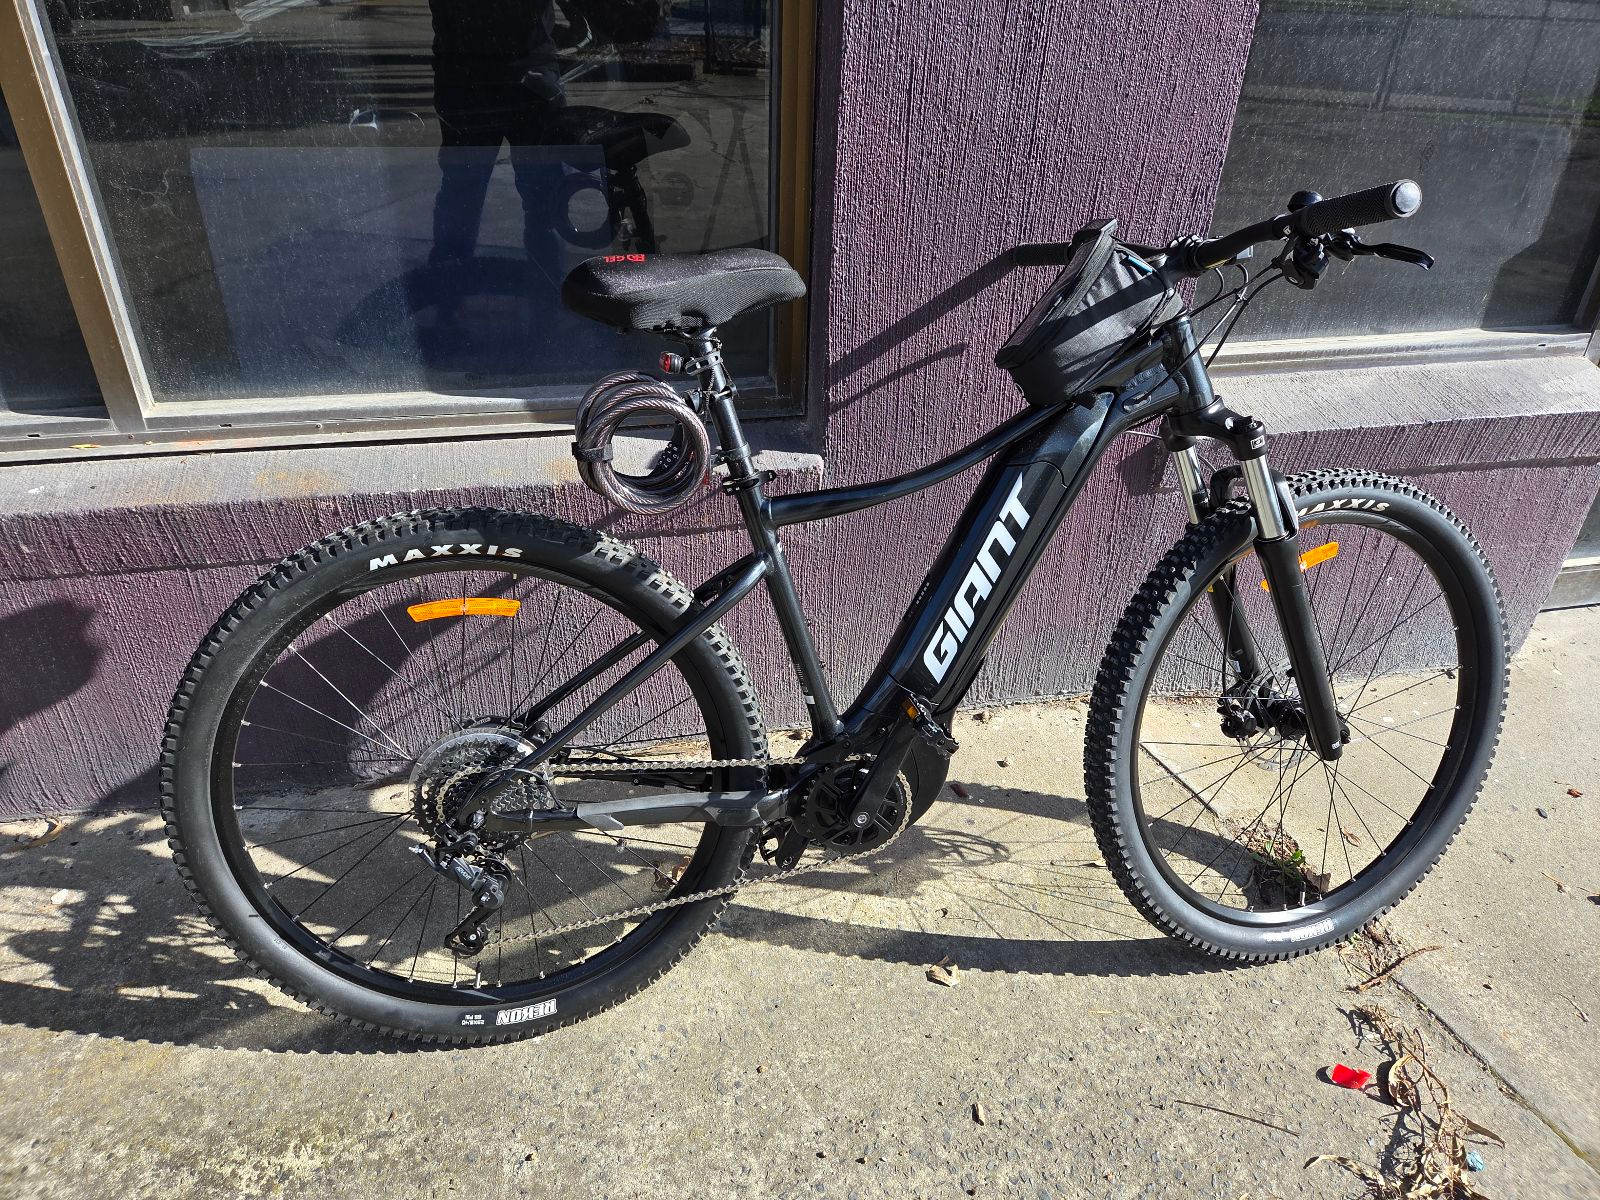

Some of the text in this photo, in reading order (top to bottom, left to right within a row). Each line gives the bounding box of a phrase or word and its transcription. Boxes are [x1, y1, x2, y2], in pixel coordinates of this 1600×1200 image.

[369, 543, 524, 571] MAXXIS
[923, 471, 1031, 685] GIANT
[496, 998, 558, 1026] REKON
